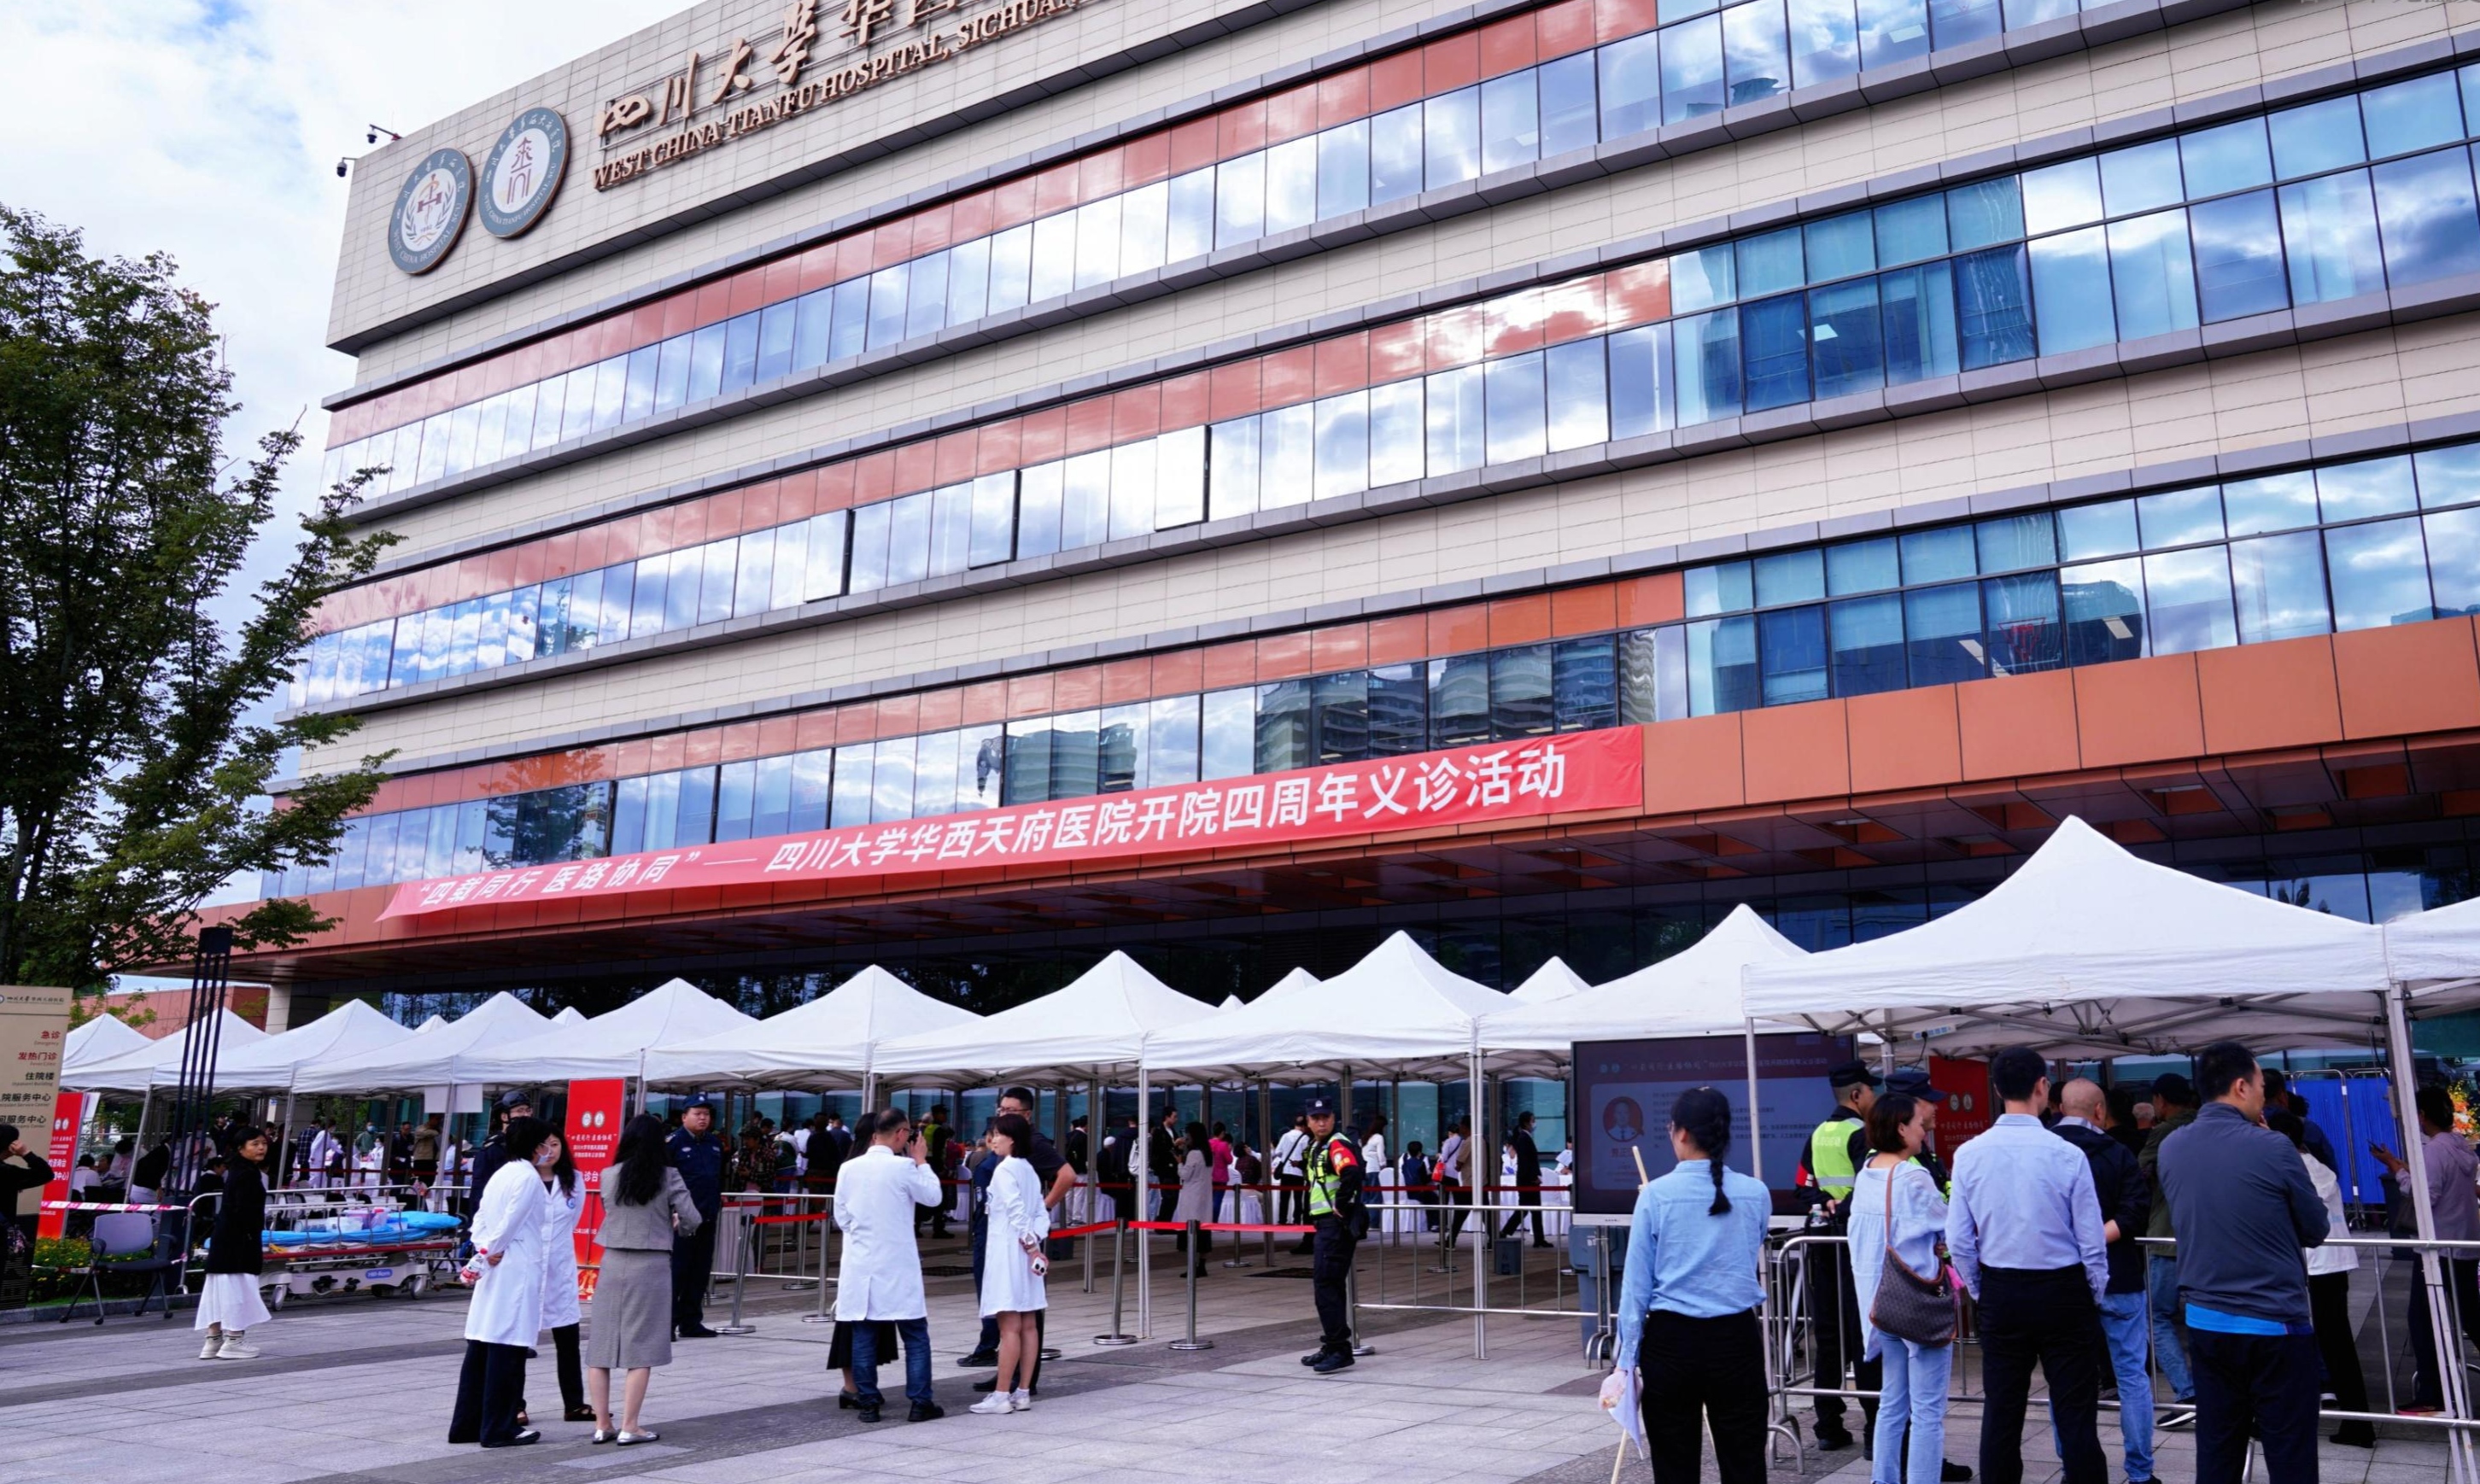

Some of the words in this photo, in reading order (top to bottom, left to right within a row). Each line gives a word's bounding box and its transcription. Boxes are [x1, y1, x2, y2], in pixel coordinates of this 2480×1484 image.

[594, 146, 648, 190] WEST
[652, 121, 722, 164] CHINA
[727, 84, 818, 137] TIANFU
[819, 34, 951, 102] HOSPITAL,
[400, 251, 418, 264] CHINA
[41, 1030, 61, 1040] 急诊
[18, 1051, 57, 1060] 发热门诊
[26, 1072, 55, 1081] 住院楼
[0, 1093, 51, 1102] 院服务中心
